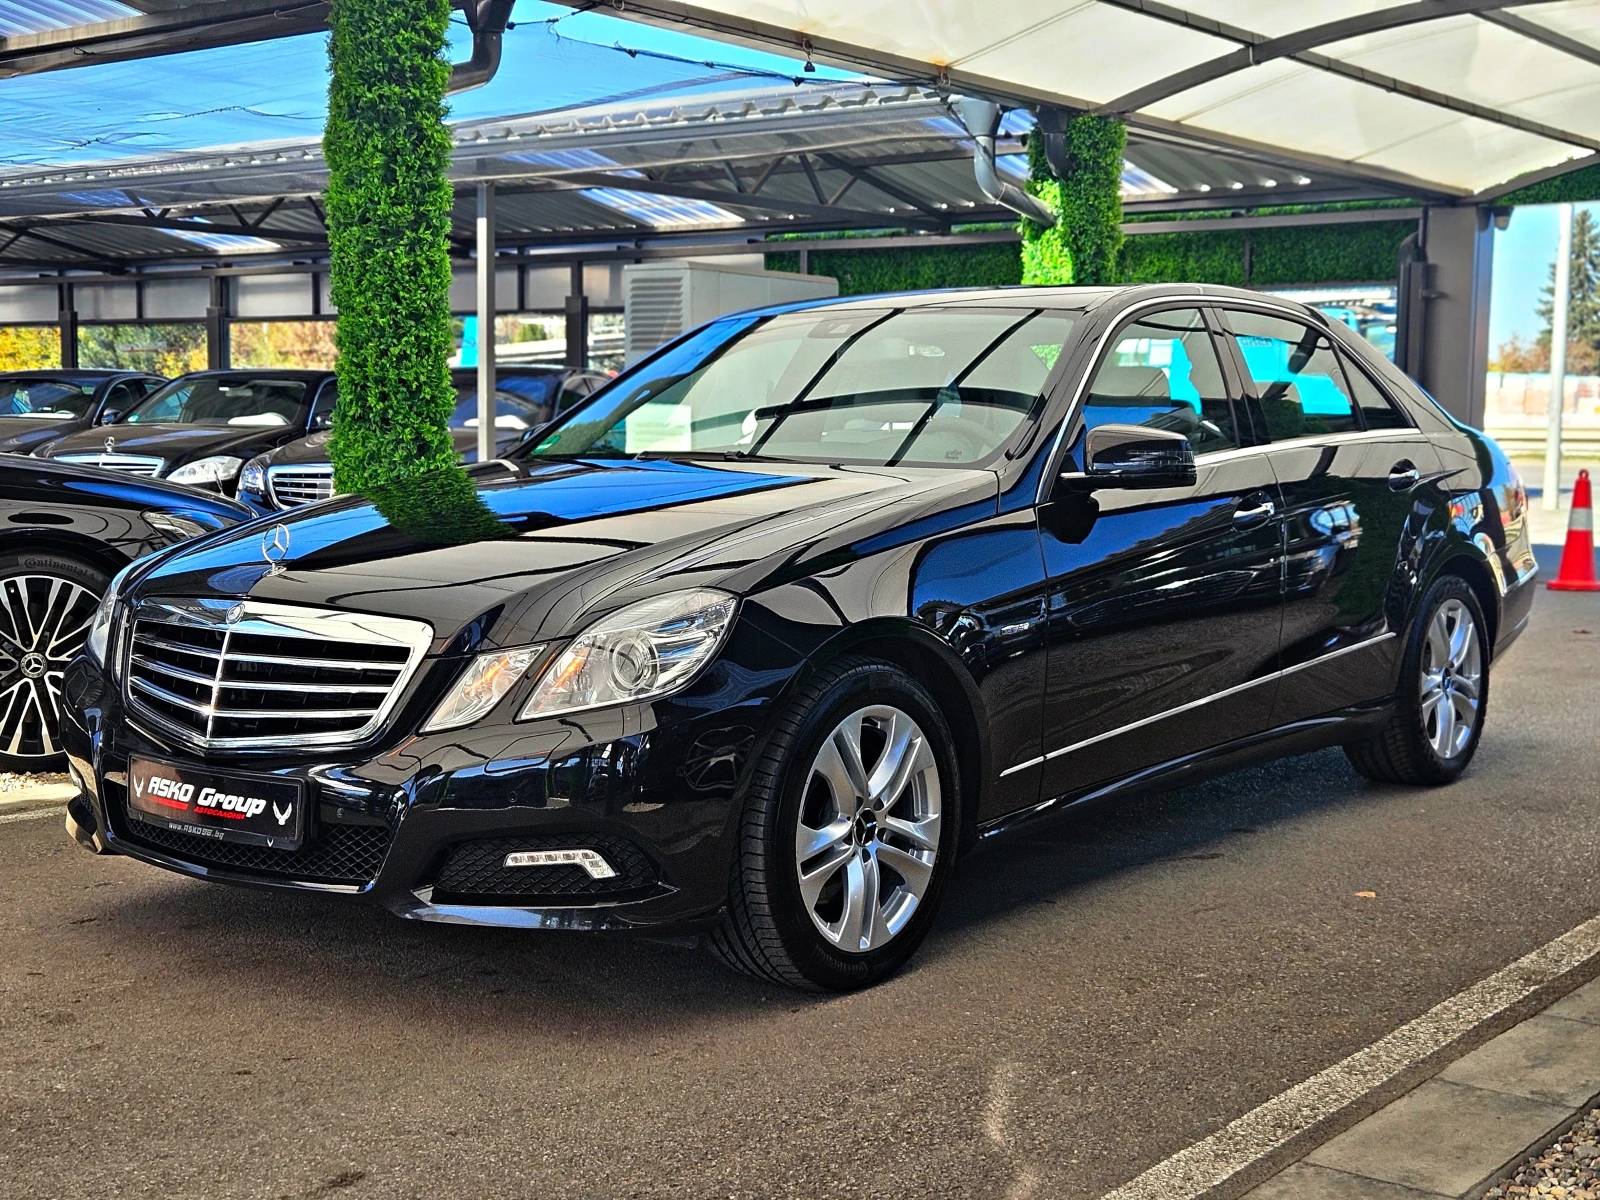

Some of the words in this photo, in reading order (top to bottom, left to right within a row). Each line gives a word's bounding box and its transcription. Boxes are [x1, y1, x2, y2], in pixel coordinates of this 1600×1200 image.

[24, 557, 88, 576] Continental
[147, 776, 194, 802] ASKO
[197, 787, 267, 818] Group
